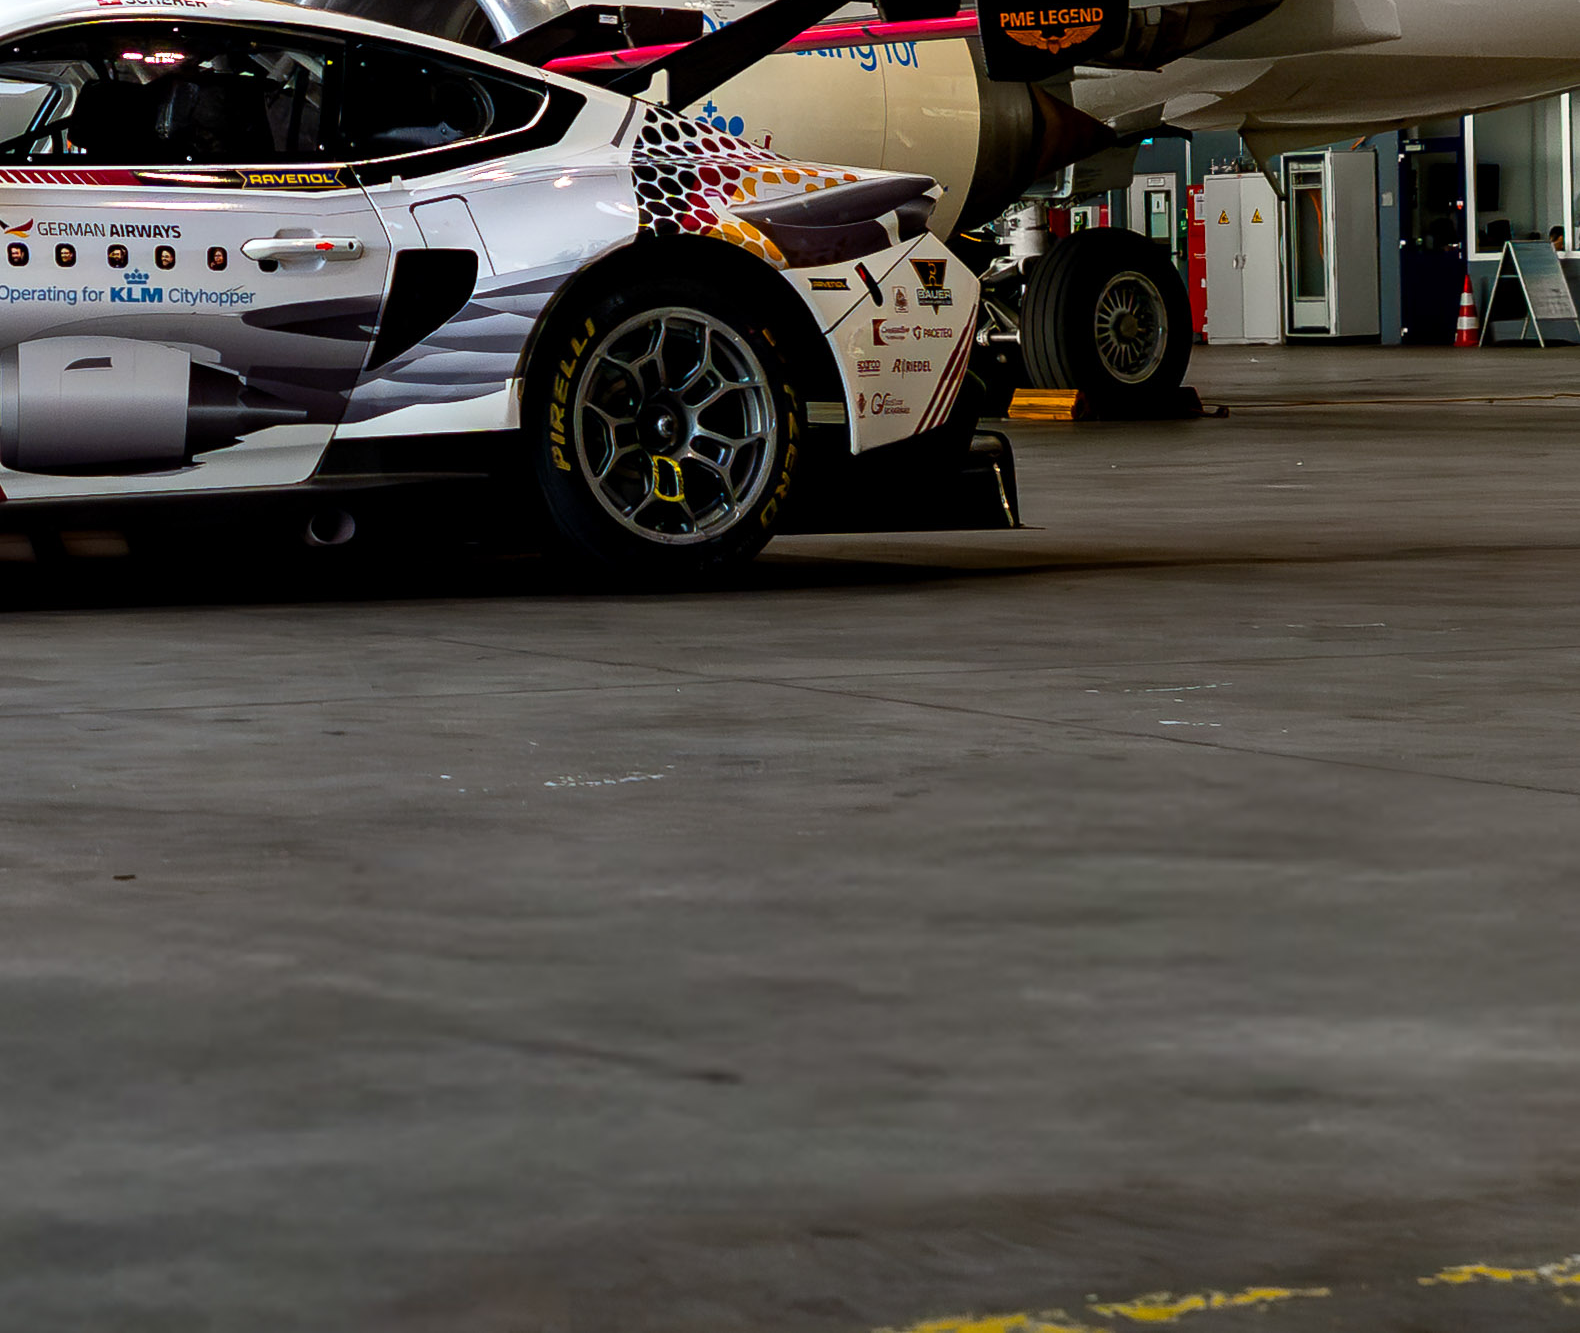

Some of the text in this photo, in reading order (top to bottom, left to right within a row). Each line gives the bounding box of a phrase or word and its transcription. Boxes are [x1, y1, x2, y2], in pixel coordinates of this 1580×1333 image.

[1000, 8, 1103, 27] PME LEGEND
[248, 172, 333, 185] RAVENOL
[37, 222, 181, 239] GERMAN AIRWAYS
[82, 285, 104, 302] for
[110, 287, 163, 303] KLM
[168, 287, 256, 307] Cityhopper
[549, 315, 596, 472] PIRELLI
